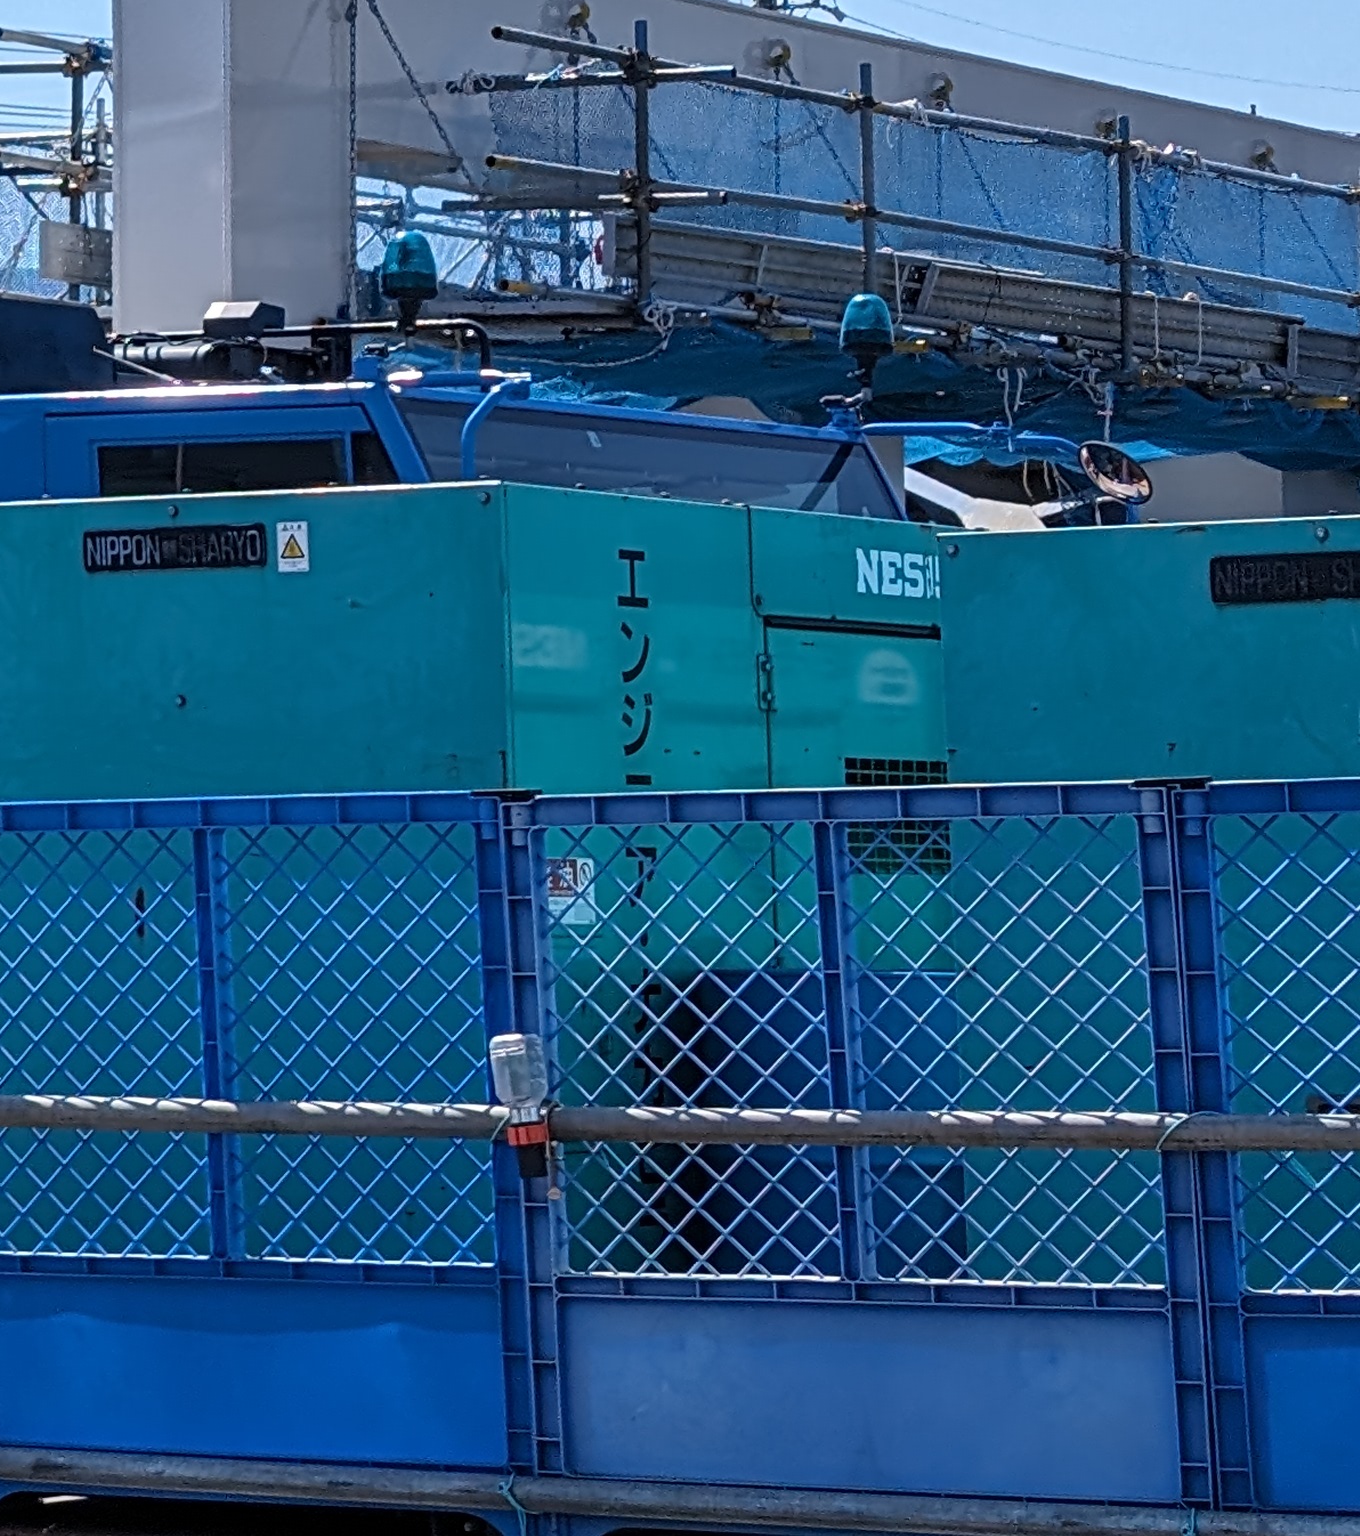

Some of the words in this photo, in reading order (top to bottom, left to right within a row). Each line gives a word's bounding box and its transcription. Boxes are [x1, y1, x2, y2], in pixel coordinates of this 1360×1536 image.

[86, 534, 162, 567] NIPPON
[177, 529, 262, 565] SHARYO
[1213, 559, 1310, 595] NIPPON
